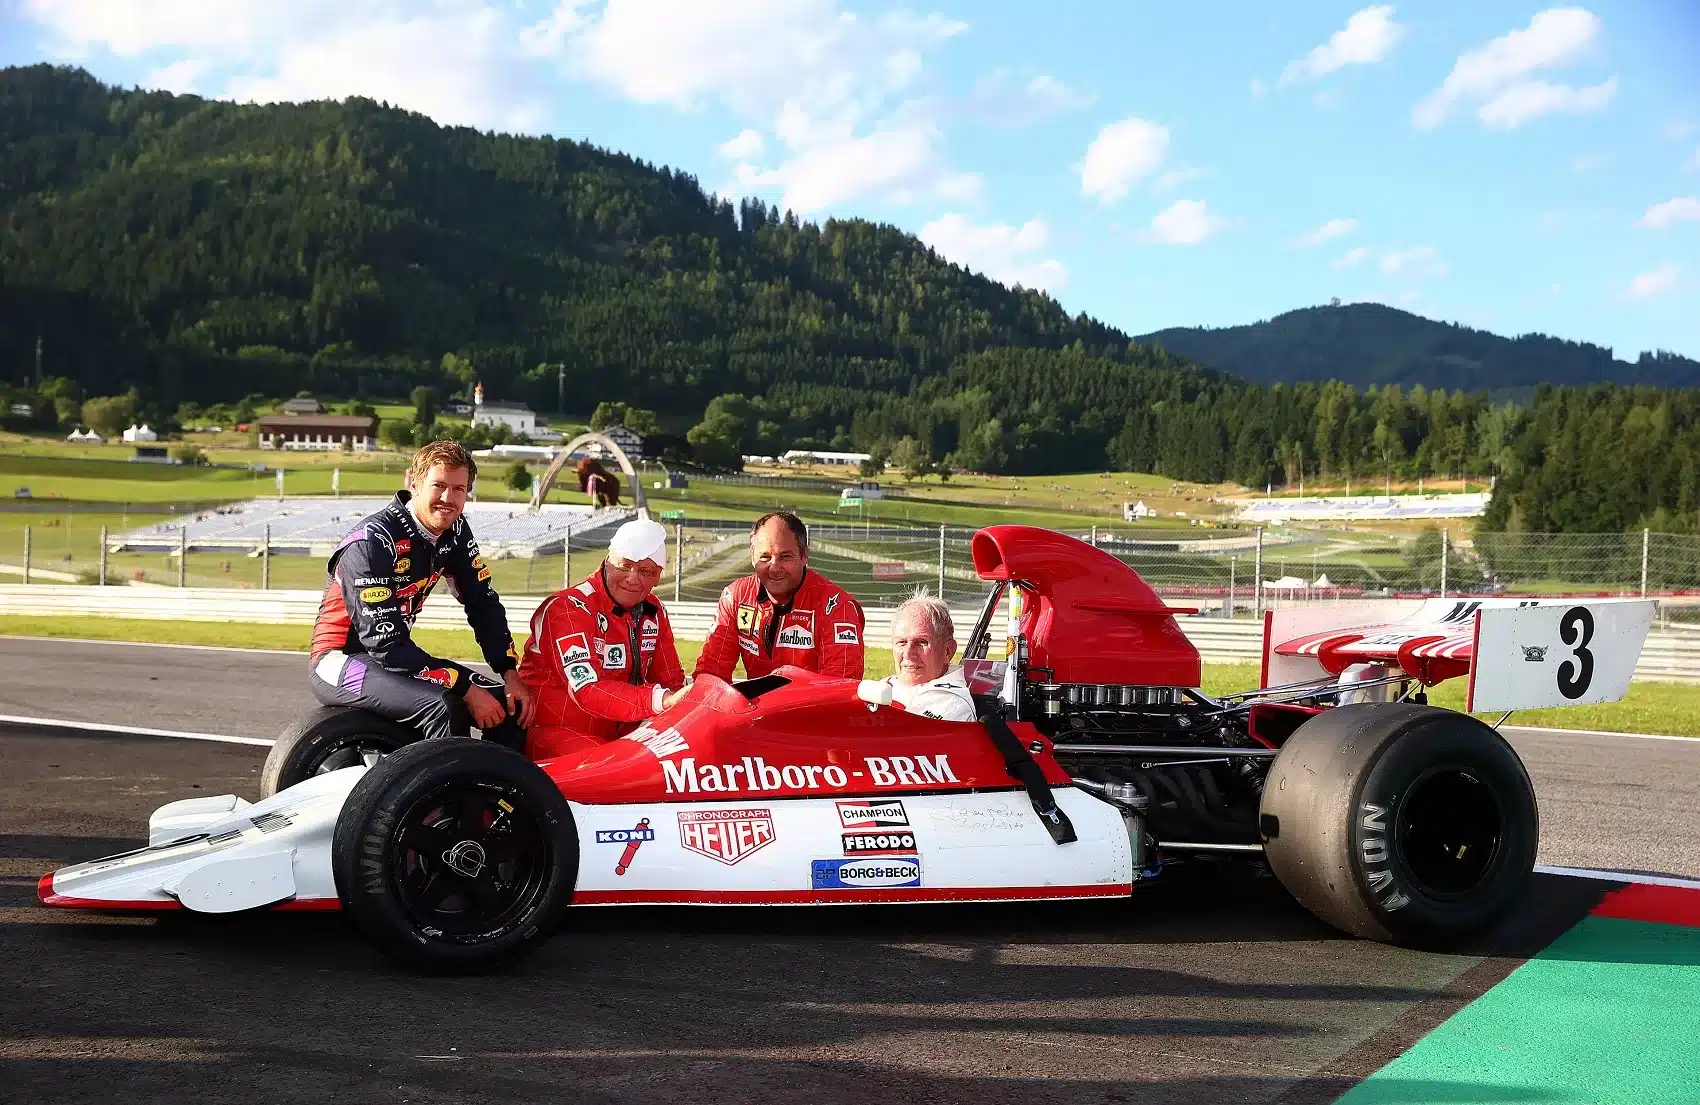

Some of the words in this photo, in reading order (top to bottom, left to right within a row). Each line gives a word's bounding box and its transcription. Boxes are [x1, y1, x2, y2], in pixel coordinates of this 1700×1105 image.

[355, 577, 390, 587] RENAULT
[367, 588, 388, 598] RAUCH
[779, 630, 812, 646] Marlboro
[563, 650, 589, 664] Marlboro
[1557, 606, 1594, 699] 3
[659, 756, 848, 794] Marlboro
[863, 754, 961, 786] BRM
[678, 810, 770, 820] CHRONOGRAPH
[843, 808, 903, 819] CHAMPION
[599, 831, 652, 842] KONI
[684, 820, 771, 859] HEUER
[844, 835, 915, 850] FERODO
[1361, 802, 1411, 912] AVON
[840, 867, 918, 879] BORG&BECK
